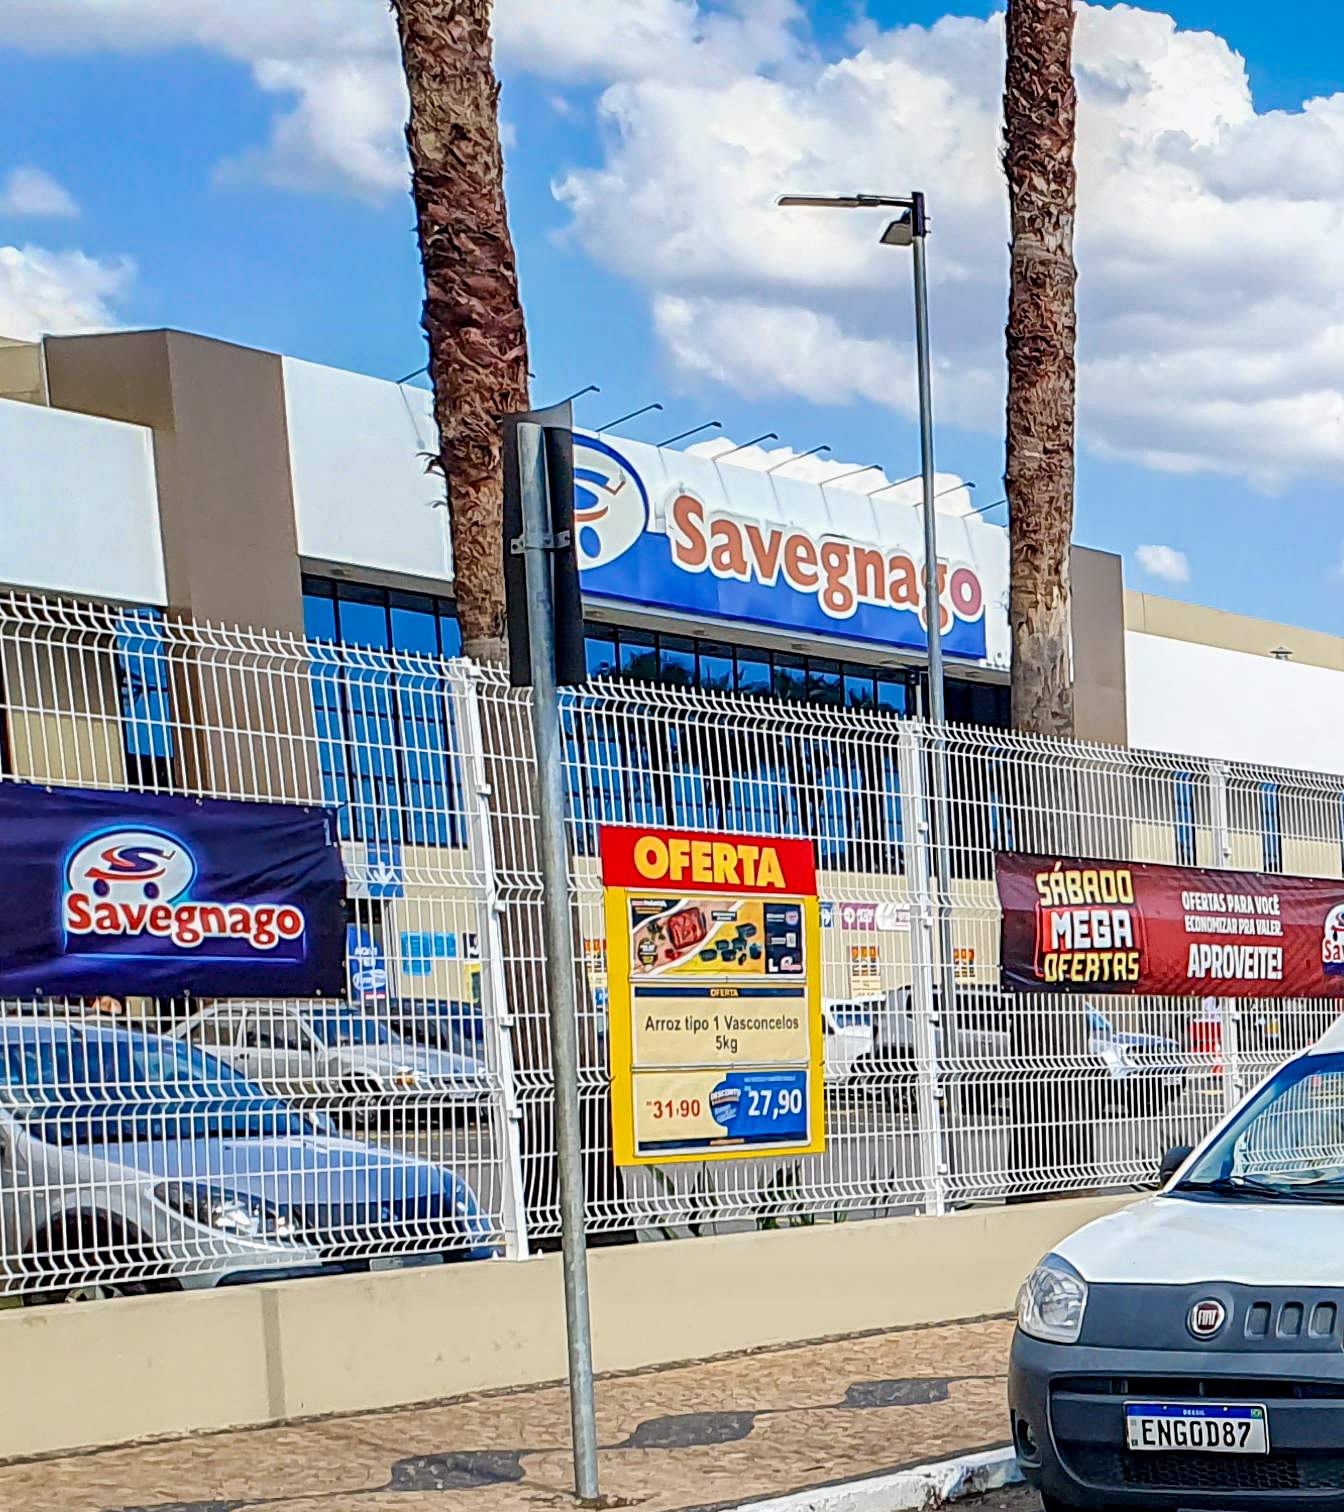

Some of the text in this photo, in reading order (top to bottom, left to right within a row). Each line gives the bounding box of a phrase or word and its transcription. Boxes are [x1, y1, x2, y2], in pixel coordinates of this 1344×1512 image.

[672, 494, 984, 632] Savegnago
[633, 835, 786, 889] OFERTA
[1036, 861, 1135, 906] SÁBADO
[66, 892, 303, 947] Savegnago
[1182, 891, 1281, 915] OFERTAS PARA VOCÊ
[1051, 910, 1134, 950] MEGA
[1184, 914, 1238, 934] ECONOMIZAR
[1238, 918, 1256, 935] PRA
[1044, 952, 1140, 982] OFERTAS
[1187, 943, 1283, 979] APROVEITE!
[710, 988, 739, 997] OFERTA
[645, 1015, 799, 1034] Arroz tipo 1 Vasconcelos
[715, 1035, 738, 1053] 5kg
[748, 1087, 803, 1121] 27,90
